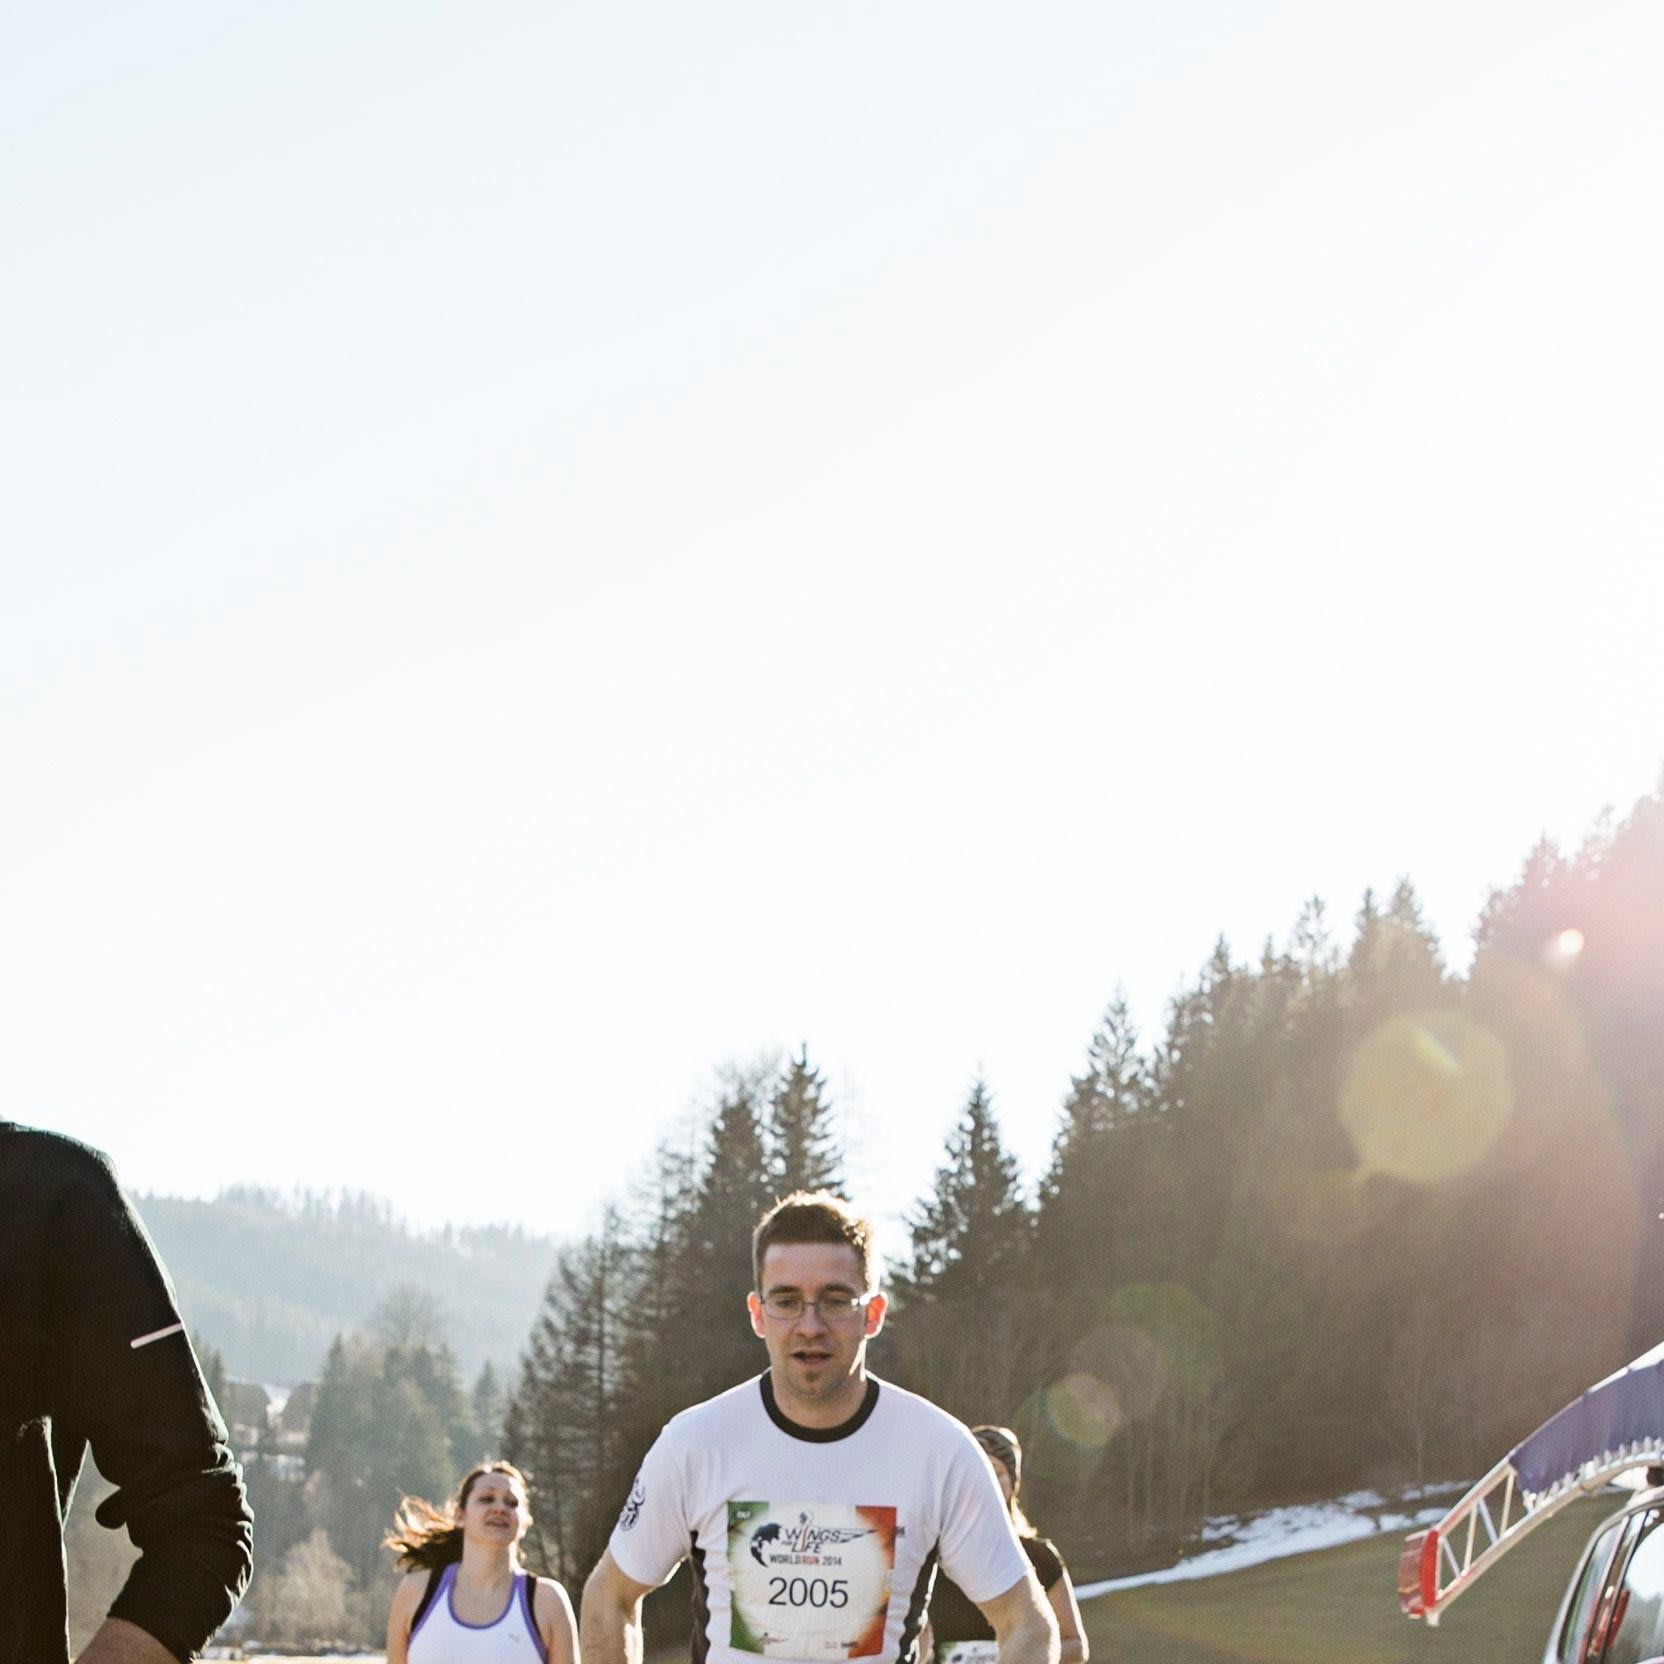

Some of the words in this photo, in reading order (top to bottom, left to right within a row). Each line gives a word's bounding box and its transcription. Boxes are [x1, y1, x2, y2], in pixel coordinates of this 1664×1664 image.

[785, 1527, 841, 1543] WINGS
[791, 1541, 824, 1554] LIFE
[822, 1555, 843, 1567] 2014
[768, 1576, 849, 1609] 2005
